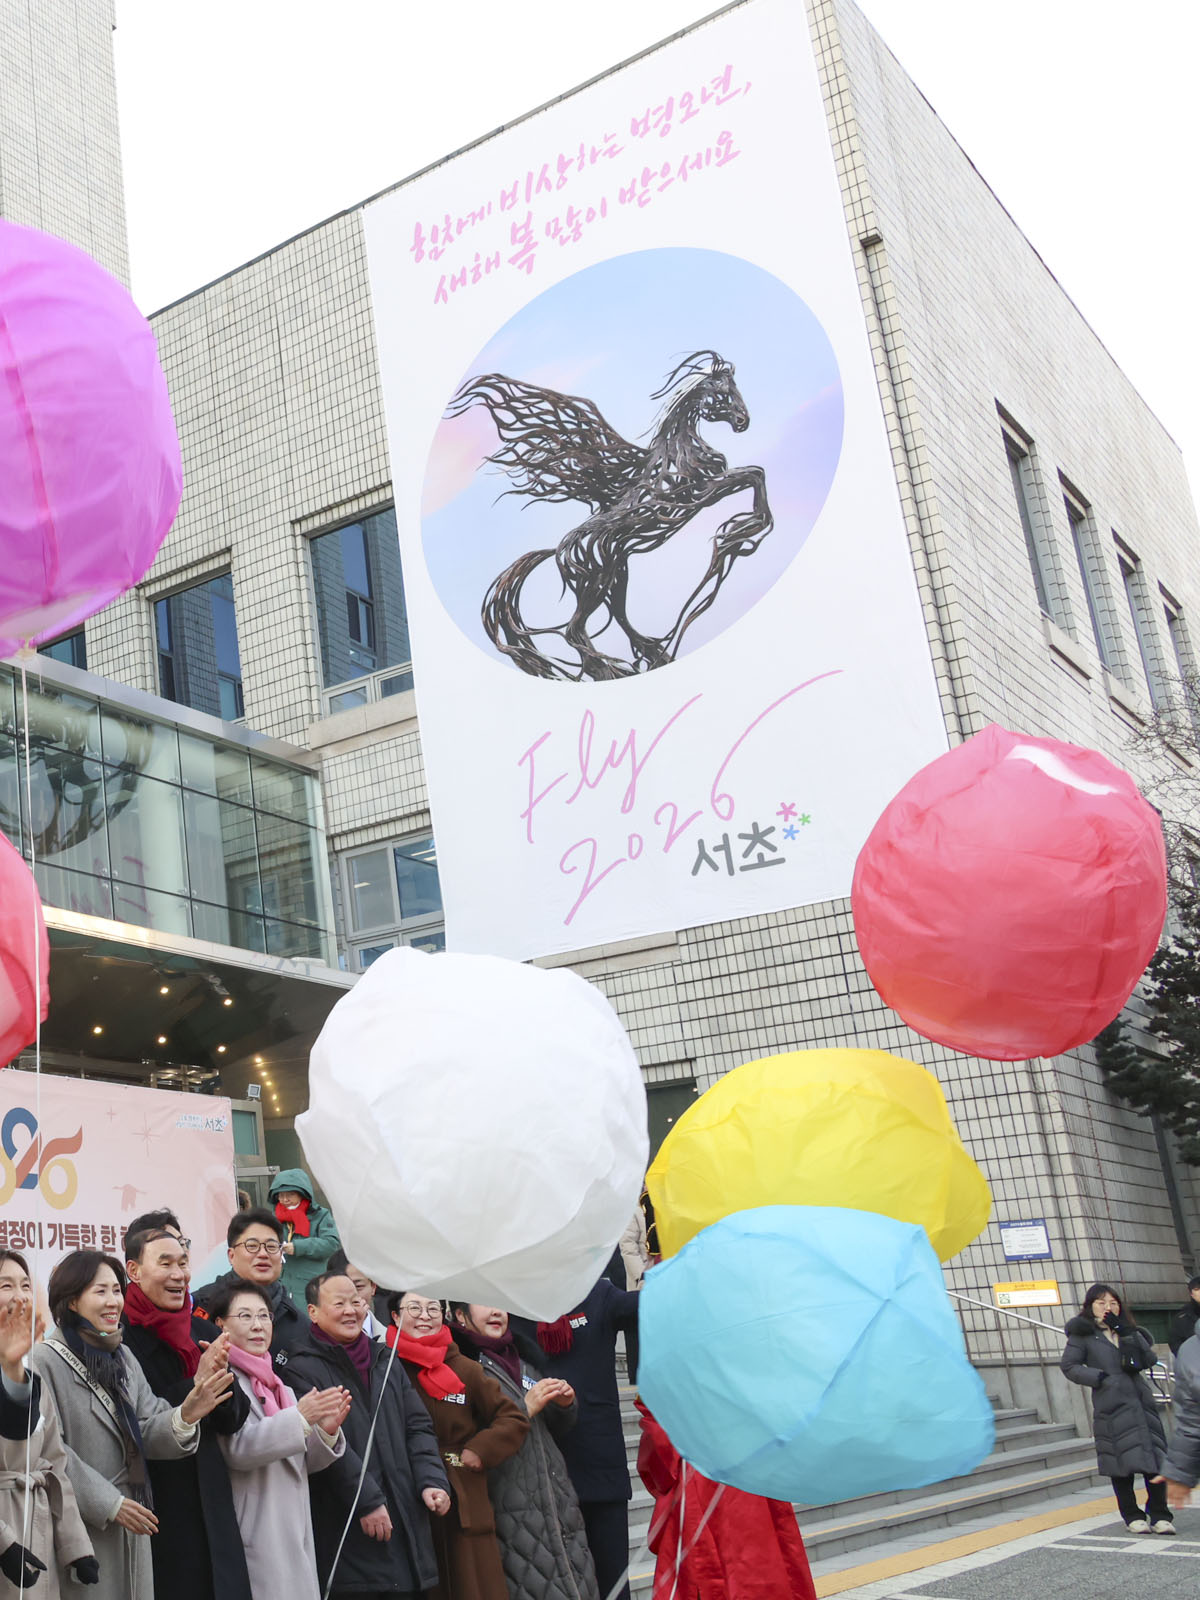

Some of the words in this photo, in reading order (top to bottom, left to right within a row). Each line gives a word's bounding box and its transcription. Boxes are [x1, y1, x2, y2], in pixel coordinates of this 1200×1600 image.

[410, 202, 492, 263] 힘차게
[500, 132, 624, 212] 비상하는
[630, 64, 752, 138] 병오년,
[433, 251, 500, 305] 새해
[508, 211, 539, 275] 복
[546, 197, 607, 247] 많이
[619, 130, 742, 208] 받으세요
[517, 693, 703, 844] Fly
[560, 669, 844, 926] 2026
[692, 822, 786, 876] 서초
[48, 1222, 97, 1252] 가득한
[101, 1225, 117, 1253] 한
